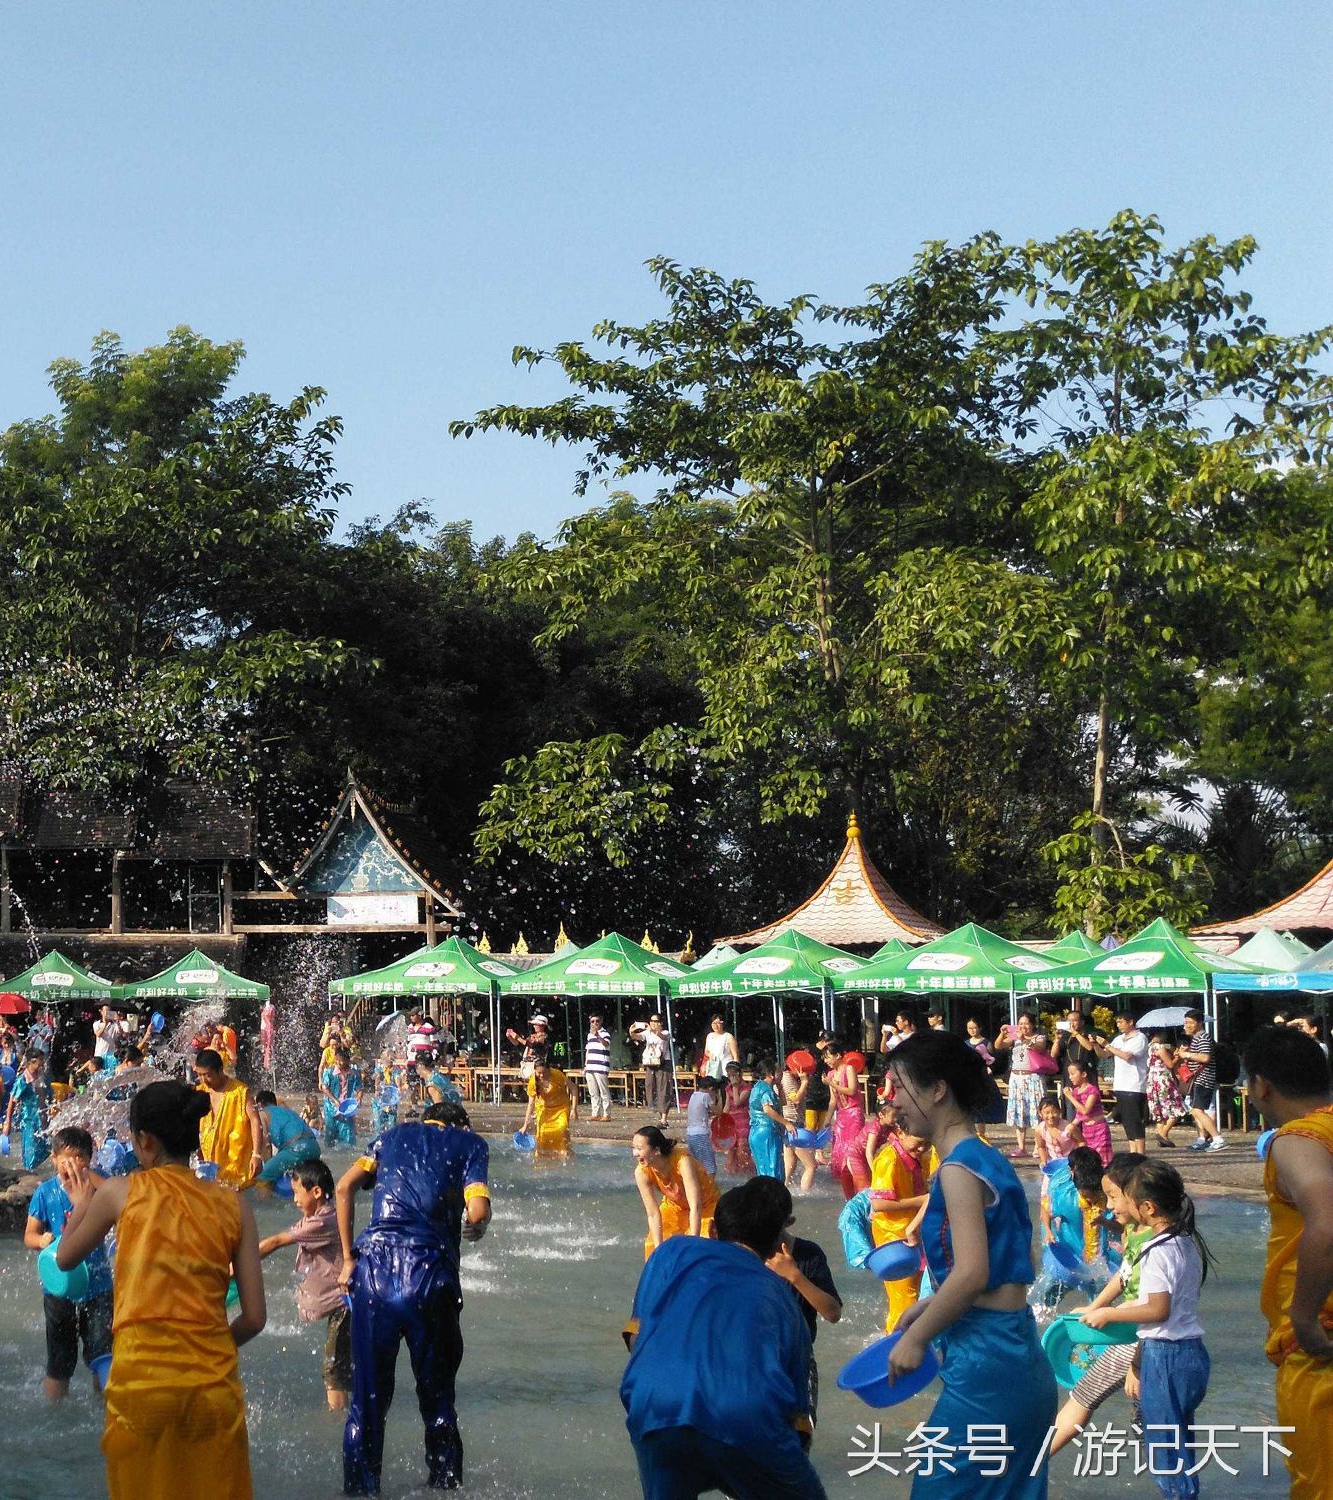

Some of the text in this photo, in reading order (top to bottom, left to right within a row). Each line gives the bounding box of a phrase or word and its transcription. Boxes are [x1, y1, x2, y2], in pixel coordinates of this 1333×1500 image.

[678, 979, 733, 995] 伊利好牛奶
[843, 976, 996, 989] 伊利好牛奶 十年奥运信赖
[1025, 977, 1093, 991] 伊利好牛奶
[135, 987, 188, 997] 伊利好牛奶
